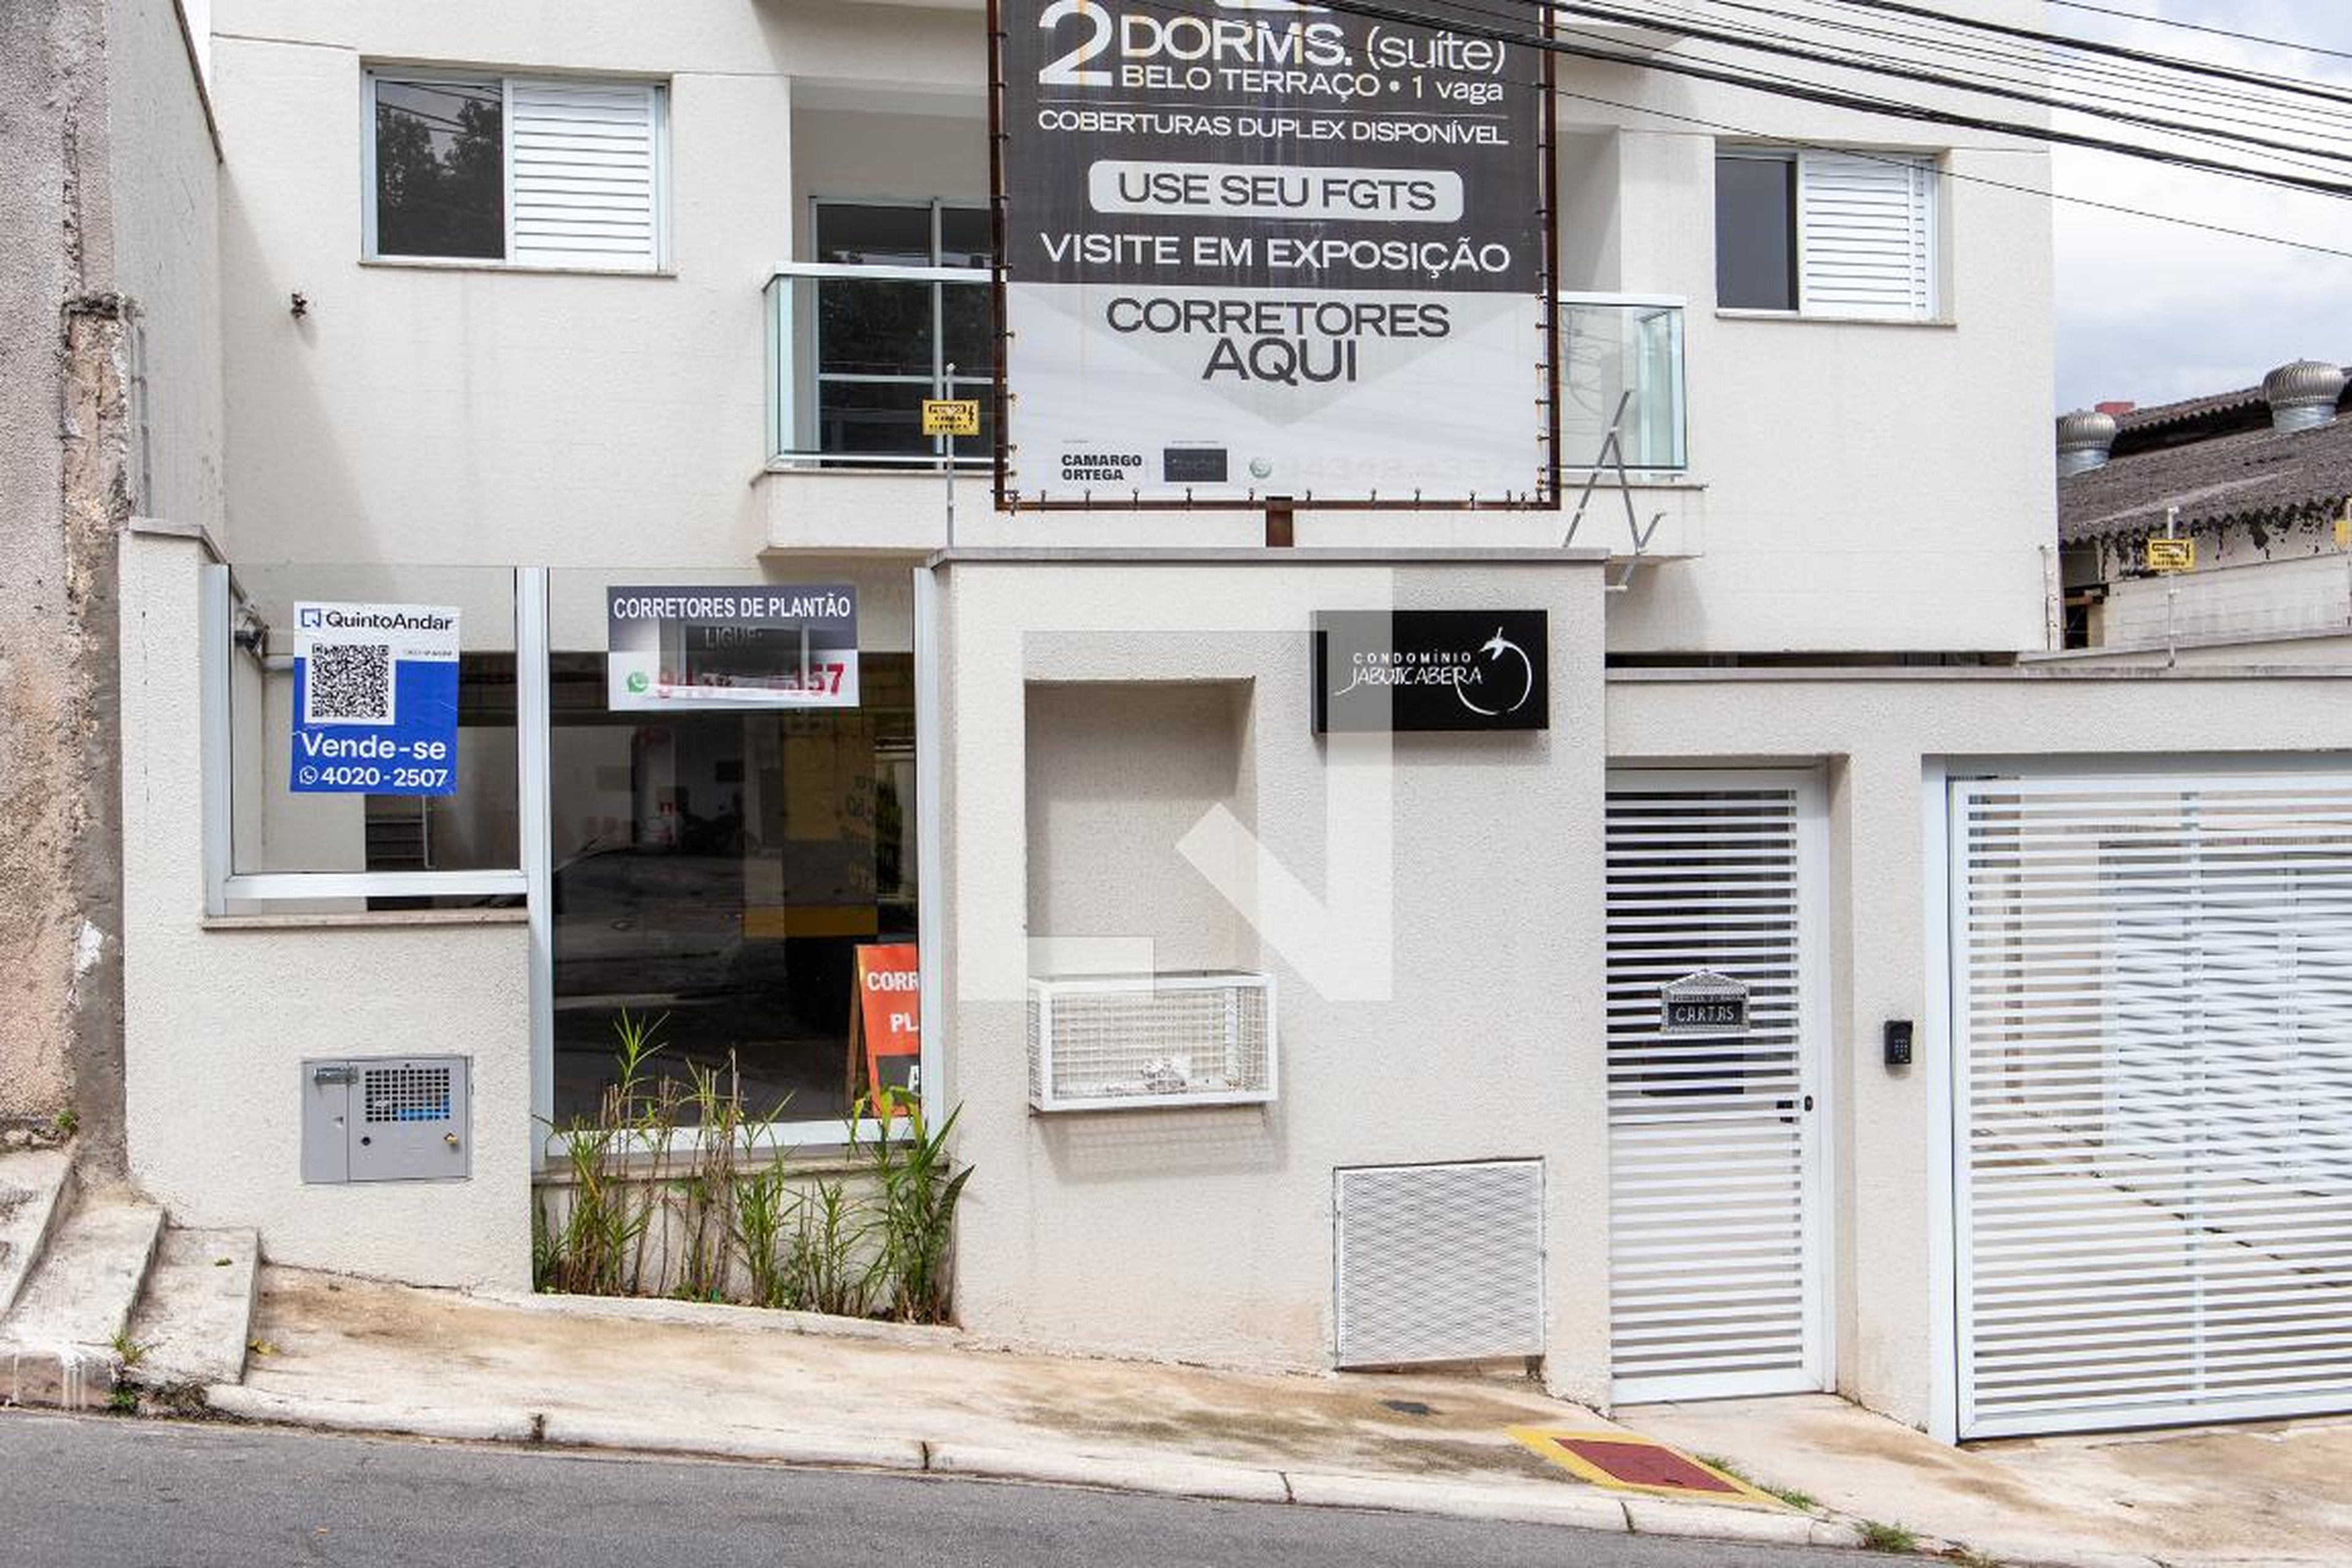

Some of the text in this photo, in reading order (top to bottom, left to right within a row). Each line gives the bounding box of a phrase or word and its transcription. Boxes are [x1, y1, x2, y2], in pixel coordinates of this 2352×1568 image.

[1038, 0, 1504, 86] 2 DORMS. (suíte)
[1121, 66, 1504, 104] BELO TERRAÇO 1 vaga
[1038, 110, 1509, 145] COBERTURAS DUPLEX DISPONÍVEL
[1118, 172, 1436, 211] USE SEU FGTS
[1040, 233, 1511, 279] VISITE EM EXPOSIÇÃO
[1106, 297, 1450, 338] CORRETORES
[1202, 339, 1357, 385] AQUI
[1061, 454, 1142, 467] CAMARGO
[1061, 469, 1125, 481] ORTEGA
[326, 611, 453, 631] QuintoAndar
[614, 593, 850, 619] CORRETORES DE PLANTÃO
[1353, 649, 1471, 664] CONDOMÍNIO
[301, 733, 447, 760] Vende-se
[1675, 1006, 1735, 1022] CARTAS
